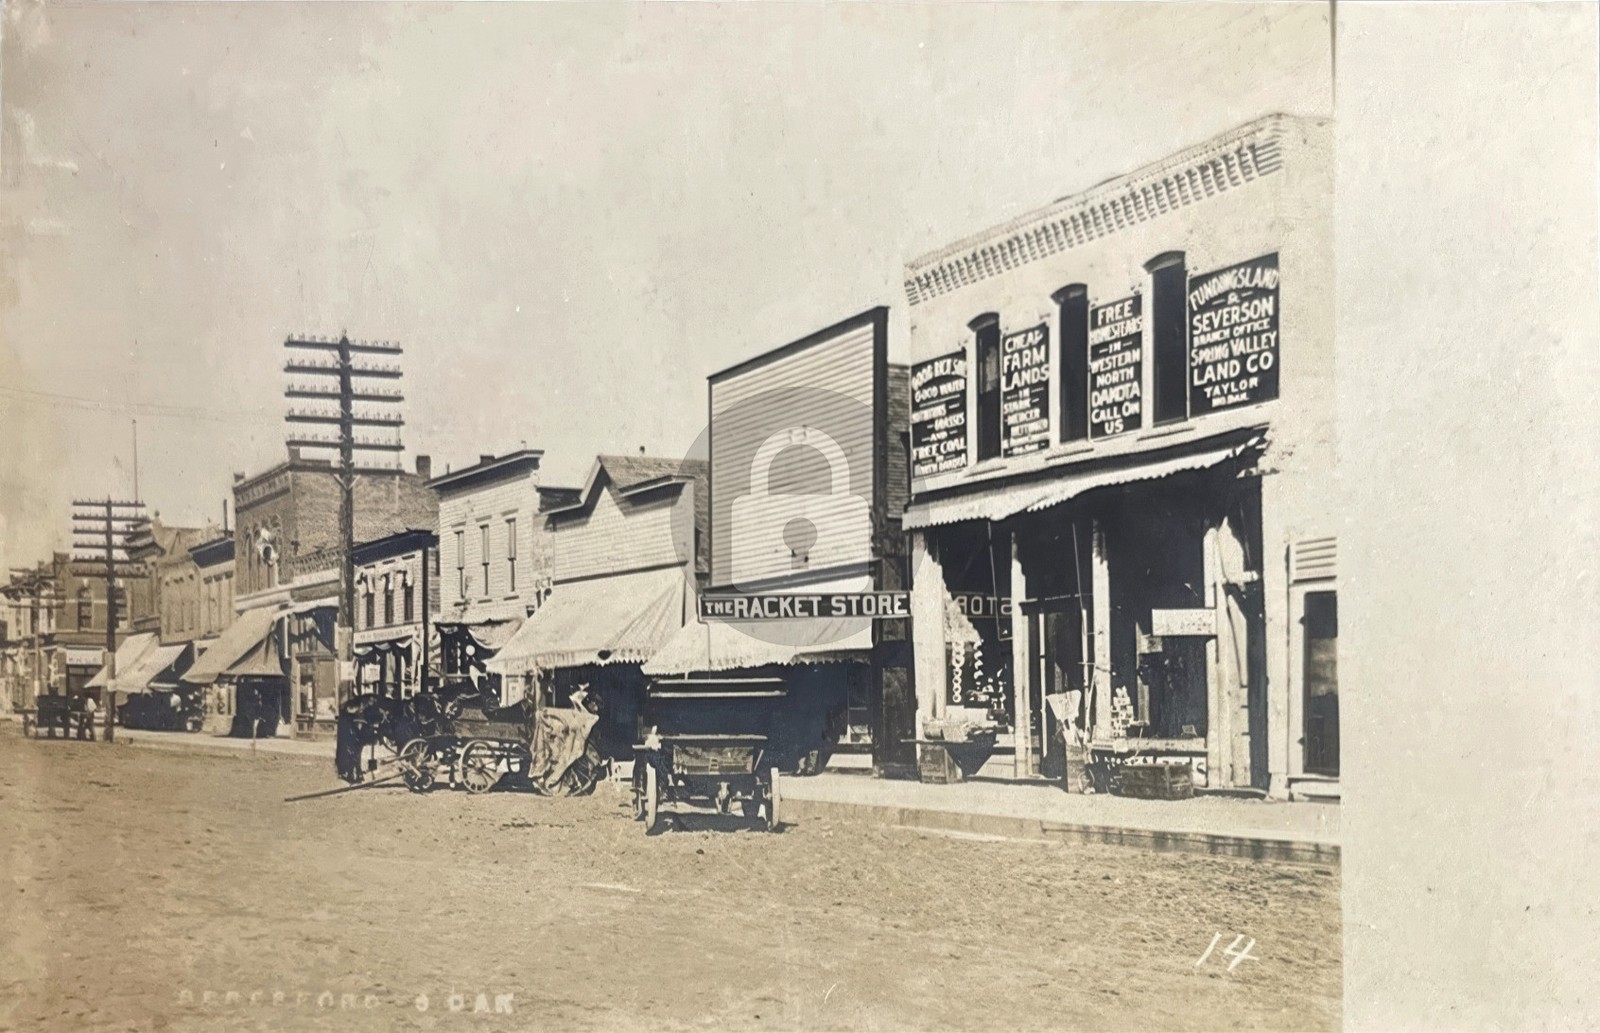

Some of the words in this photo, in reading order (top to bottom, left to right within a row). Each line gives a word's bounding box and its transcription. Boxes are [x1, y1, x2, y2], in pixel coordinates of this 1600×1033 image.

[1098, 300, 1134, 326] FREE
[1193, 296, 1274, 335] SEVERSON
[1005, 330, 1043, 353] CHEAP
[1193, 328, 1230, 348] BRANCH
[1233, 318, 1271, 337] OFFICE
[1003, 344, 1046, 374] FARM
[1109, 341, 1122, 354] IN
[1191, 343, 1229, 367] SPRING
[1230, 331, 1277, 357] VALLEY
[1091, 348, 1141, 374] WESTERN
[1193, 359, 1240, 386] LAND
[1246, 351, 1273, 374] CO
[1001, 364, 1050, 392] LANDS
[1097, 366, 1135, 388] NORTH
[1204, 377, 1259, 398] TAYLOR
[1092, 381, 1140, 408] DAKOTA
[1091, 406, 1121, 424] CALL
[1122, 402, 1140, 417] ON
[1104, 418, 1124, 434] US
[940, 437, 967, 455] COAL
[705, 601, 733, 615] THE
[734, 596, 822, 618] RACKET
[831, 594, 908, 616] STORE
